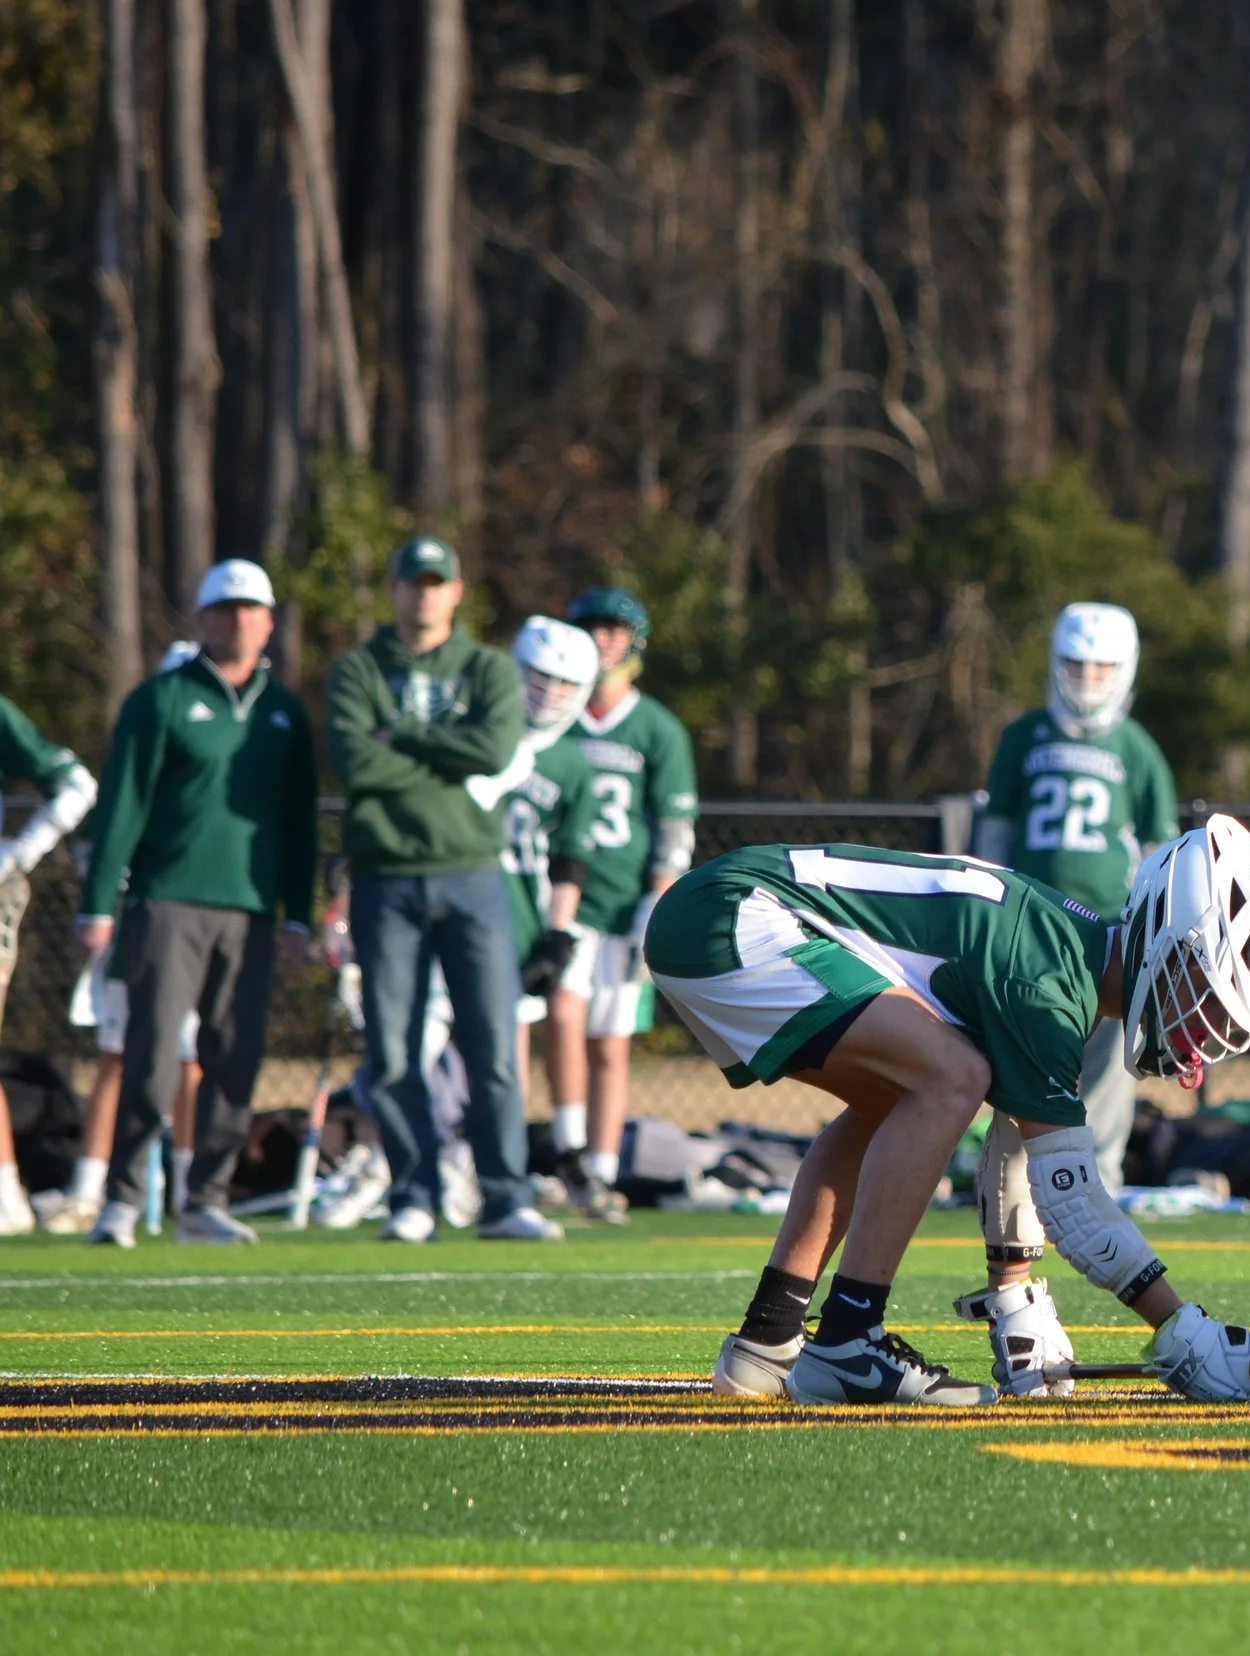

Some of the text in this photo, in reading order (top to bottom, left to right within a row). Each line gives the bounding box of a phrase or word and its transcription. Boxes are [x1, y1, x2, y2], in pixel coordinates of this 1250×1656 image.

[589, 774, 633, 847] 3
[1026, 776, 1111, 853] 22
[784, 848, 1012, 906] 1
[1023, 1247, 1044, 1258] G-FO
